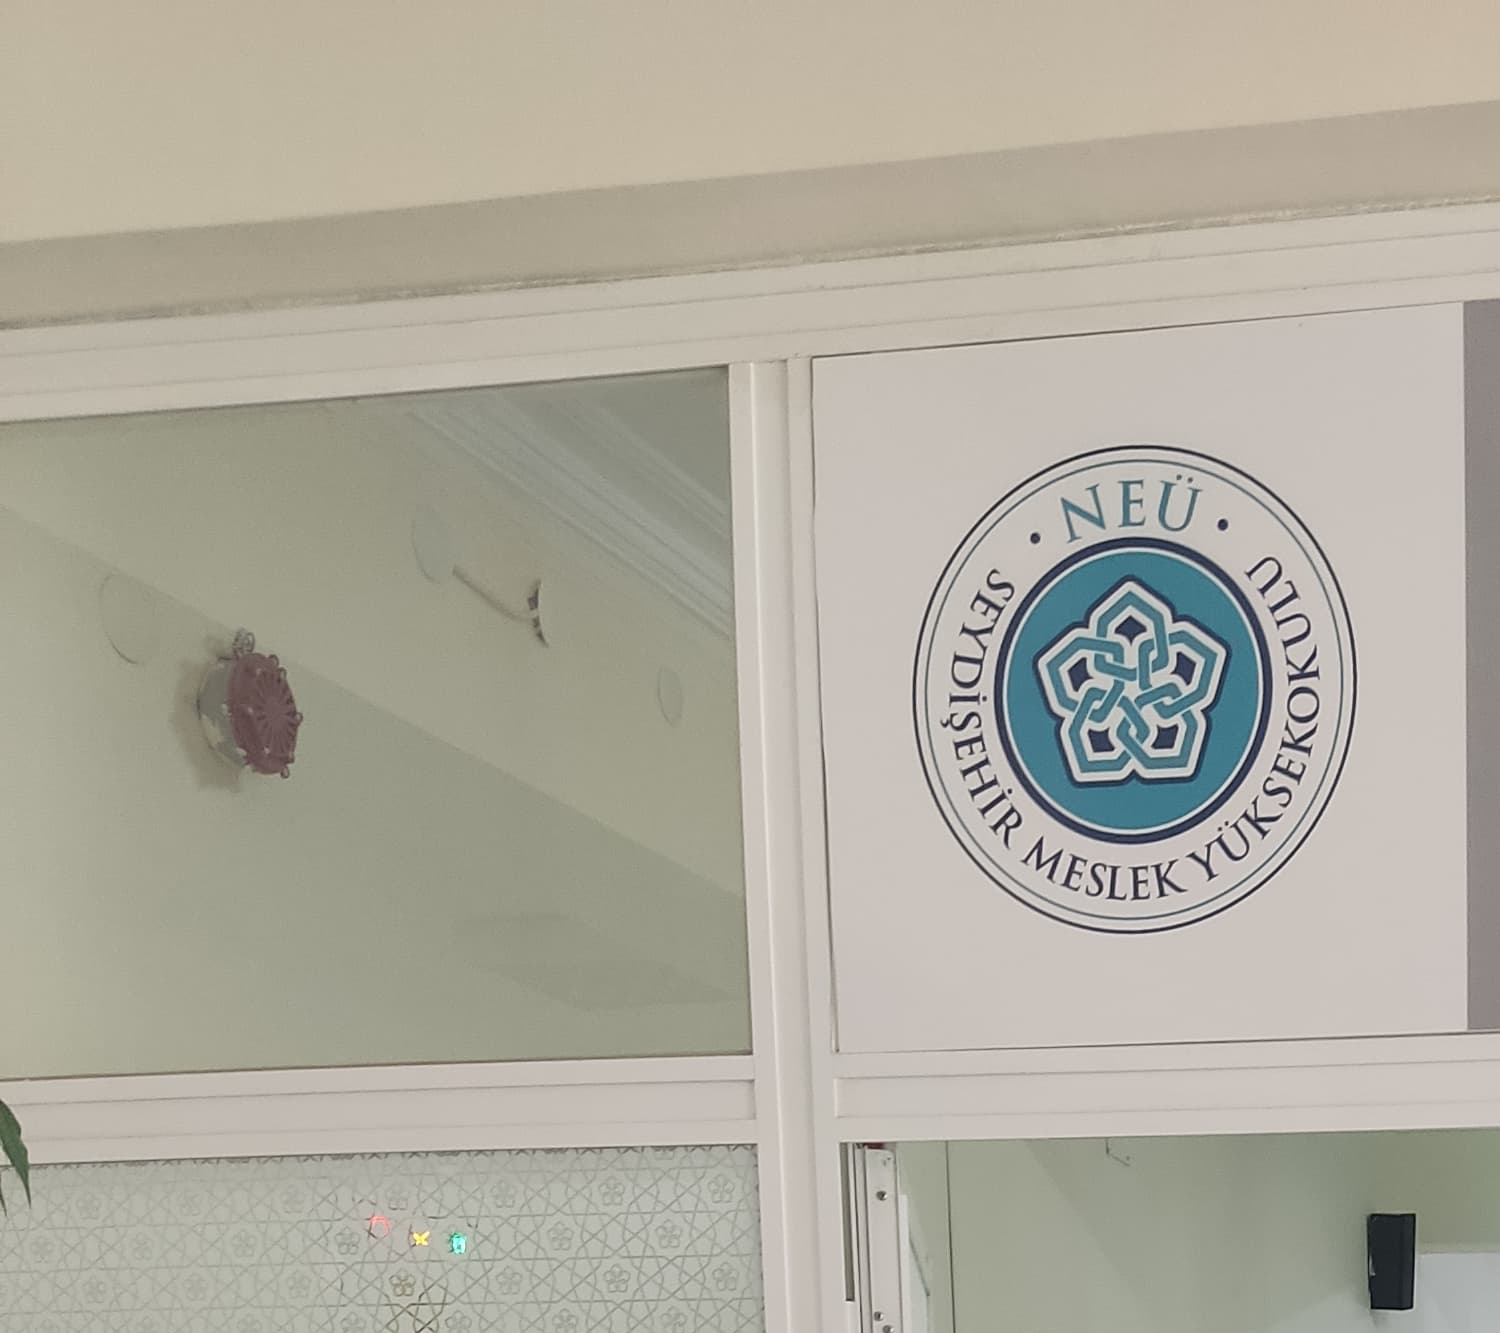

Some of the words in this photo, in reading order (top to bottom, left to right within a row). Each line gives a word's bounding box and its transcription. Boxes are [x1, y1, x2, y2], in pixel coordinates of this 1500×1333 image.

[1060, 474, 1203, 543] NEÜ
[940, 568, 1028, 850] SEYDİŞEHİR
[1021, 834, 1188, 902] MESLEK
[1187, 556, 1321, 883] YÜKSEKOKULU
